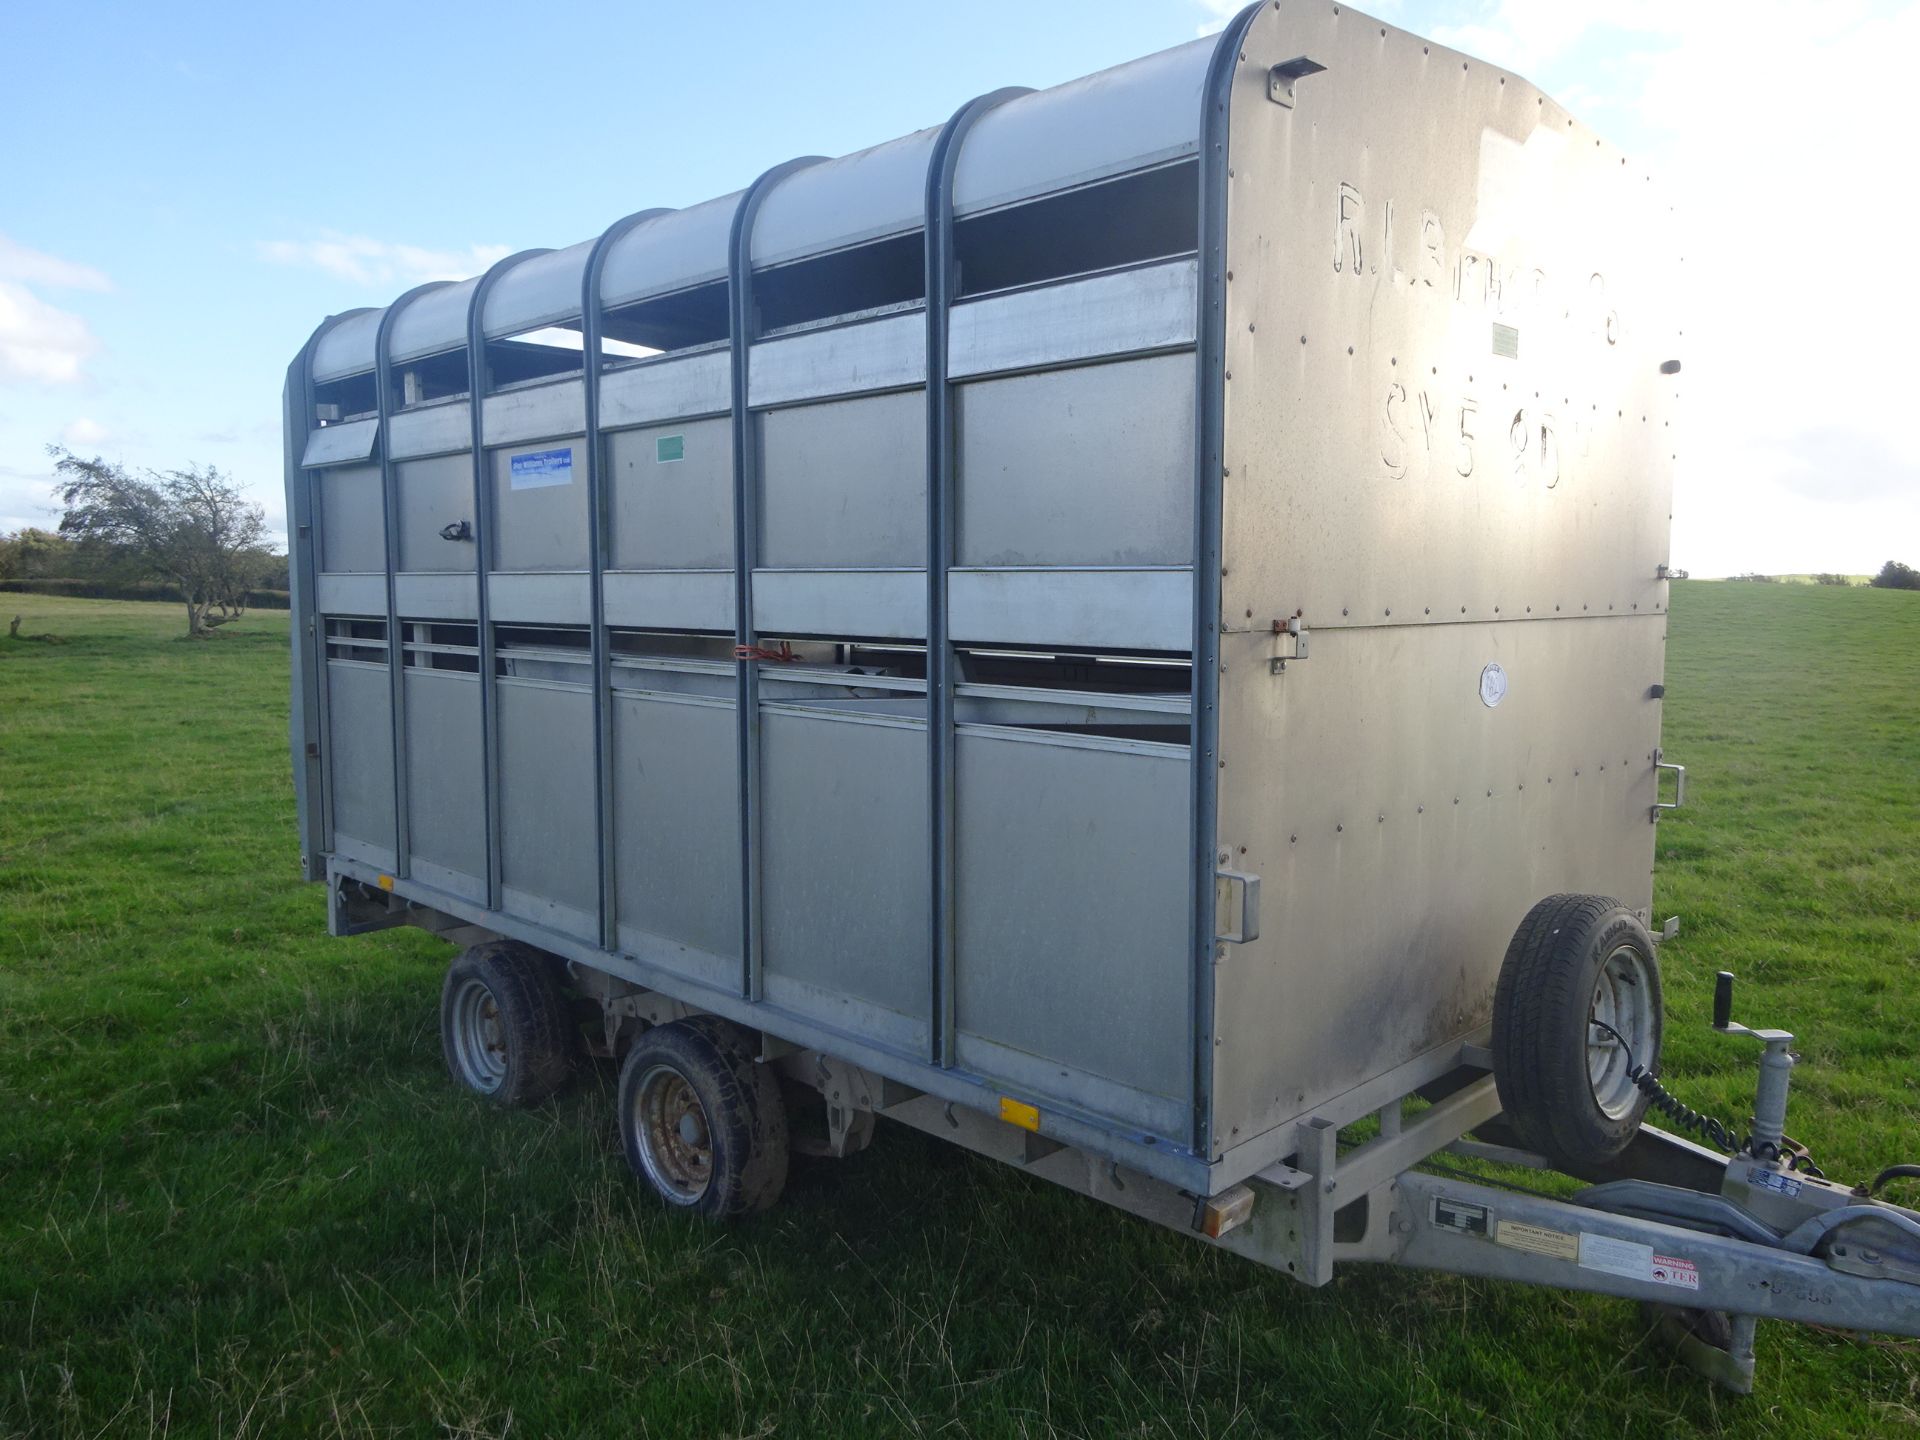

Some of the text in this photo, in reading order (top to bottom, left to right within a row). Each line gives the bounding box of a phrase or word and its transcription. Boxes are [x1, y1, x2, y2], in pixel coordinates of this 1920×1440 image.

[1510, 1225, 1564, 1240] IMPORTANT NOTICE
[1653, 1257, 1694, 1270] WARNING
[1670, 1271, 1697, 1283] TER
